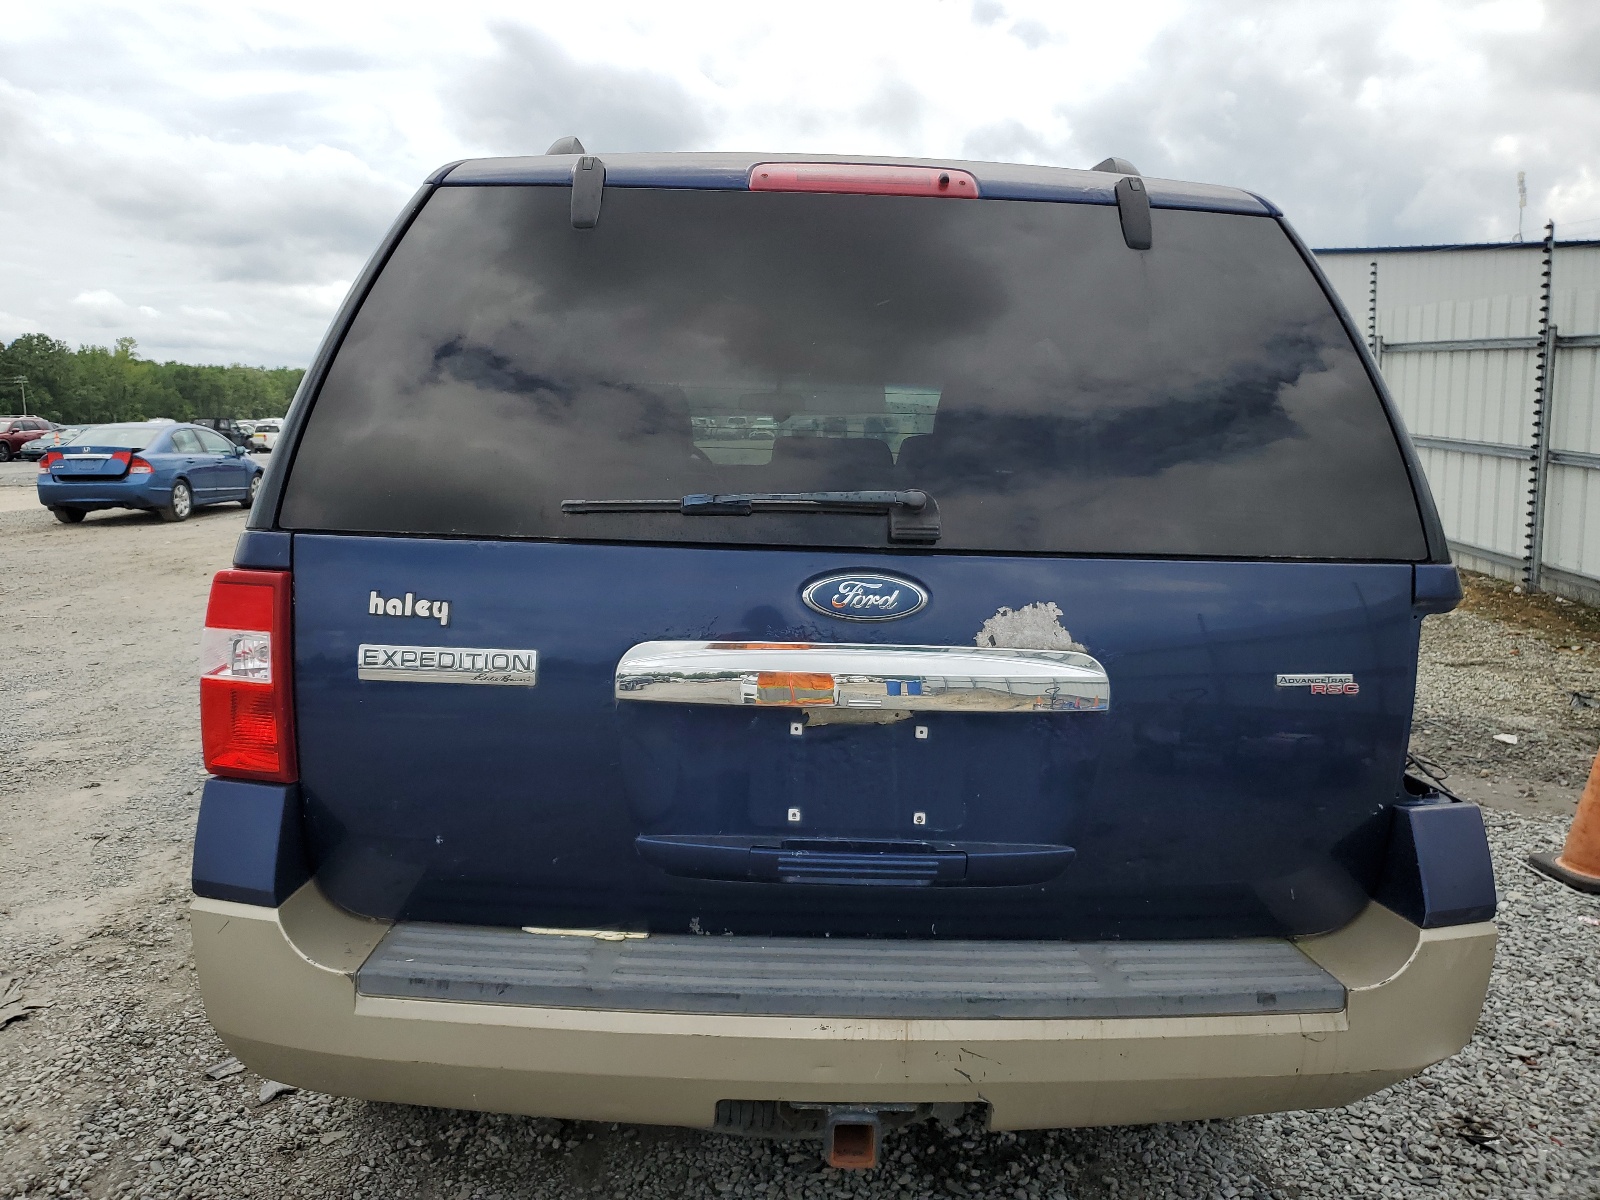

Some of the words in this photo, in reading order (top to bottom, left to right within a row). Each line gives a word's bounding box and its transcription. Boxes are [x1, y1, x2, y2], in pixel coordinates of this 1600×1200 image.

[832, 581, 900, 609] Ford
[368, 590, 450, 627] haley
[362, 649, 532, 671] EXPEDITION
[1311, 683, 1359, 694] RSC
